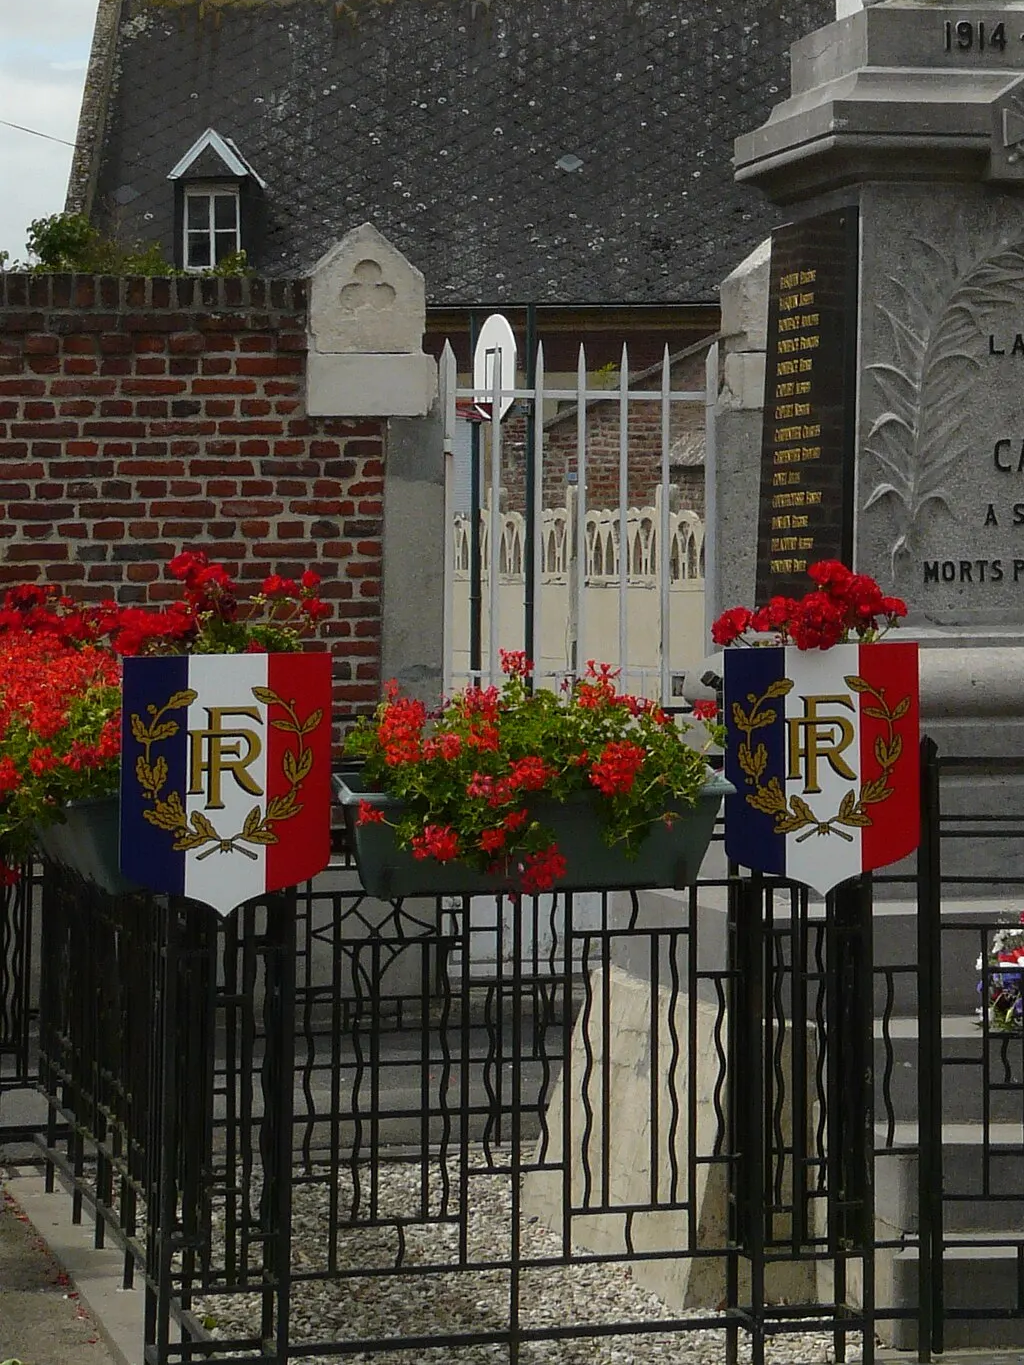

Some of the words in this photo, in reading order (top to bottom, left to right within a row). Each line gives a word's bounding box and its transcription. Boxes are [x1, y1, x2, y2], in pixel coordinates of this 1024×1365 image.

[943, 19, 1008, 53] 1914
[984, 503, 999, 526] A
[923, 559, 1004, 583] MORTS
